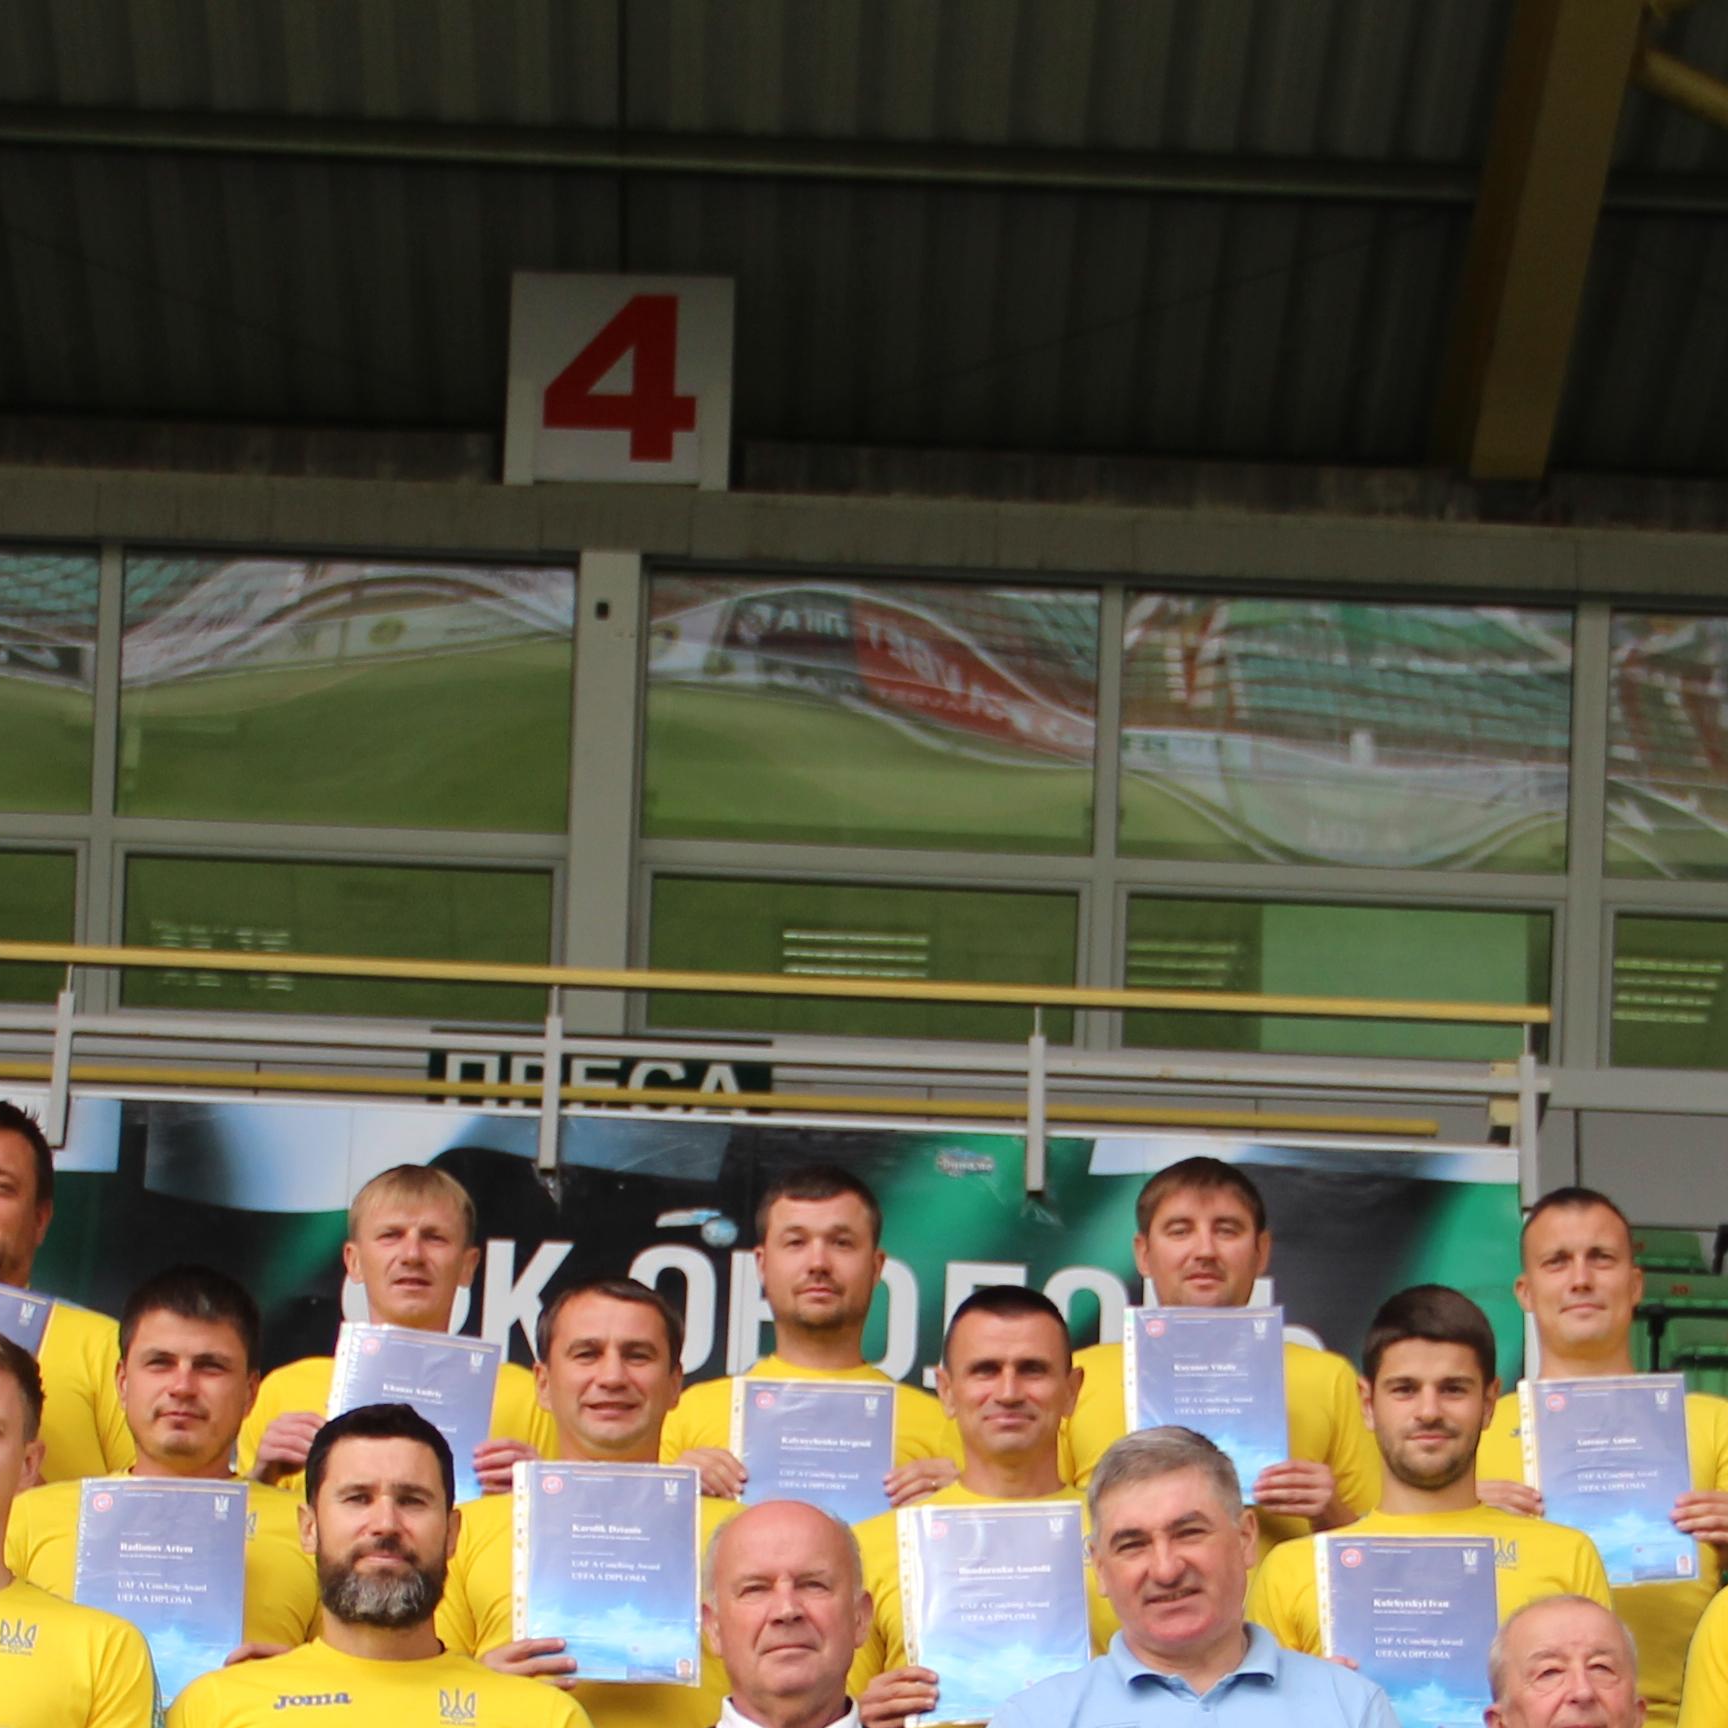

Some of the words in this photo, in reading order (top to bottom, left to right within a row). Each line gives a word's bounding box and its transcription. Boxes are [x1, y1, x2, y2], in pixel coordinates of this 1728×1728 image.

[543, 294, 697, 462] 4
[164, 1543, 193, 1553] Artem
[118, 1581, 135, 1590] UAF
[139, 1582, 145, 1590] A
[146, 1582, 181, 1593] Coaching
[184, 1584, 207, 1592] Award
[117, 1594, 140, 1602] UEFA
[141, 1595, 148, 1603] A
[150, 1595, 193, 1605] DIPLOMA
